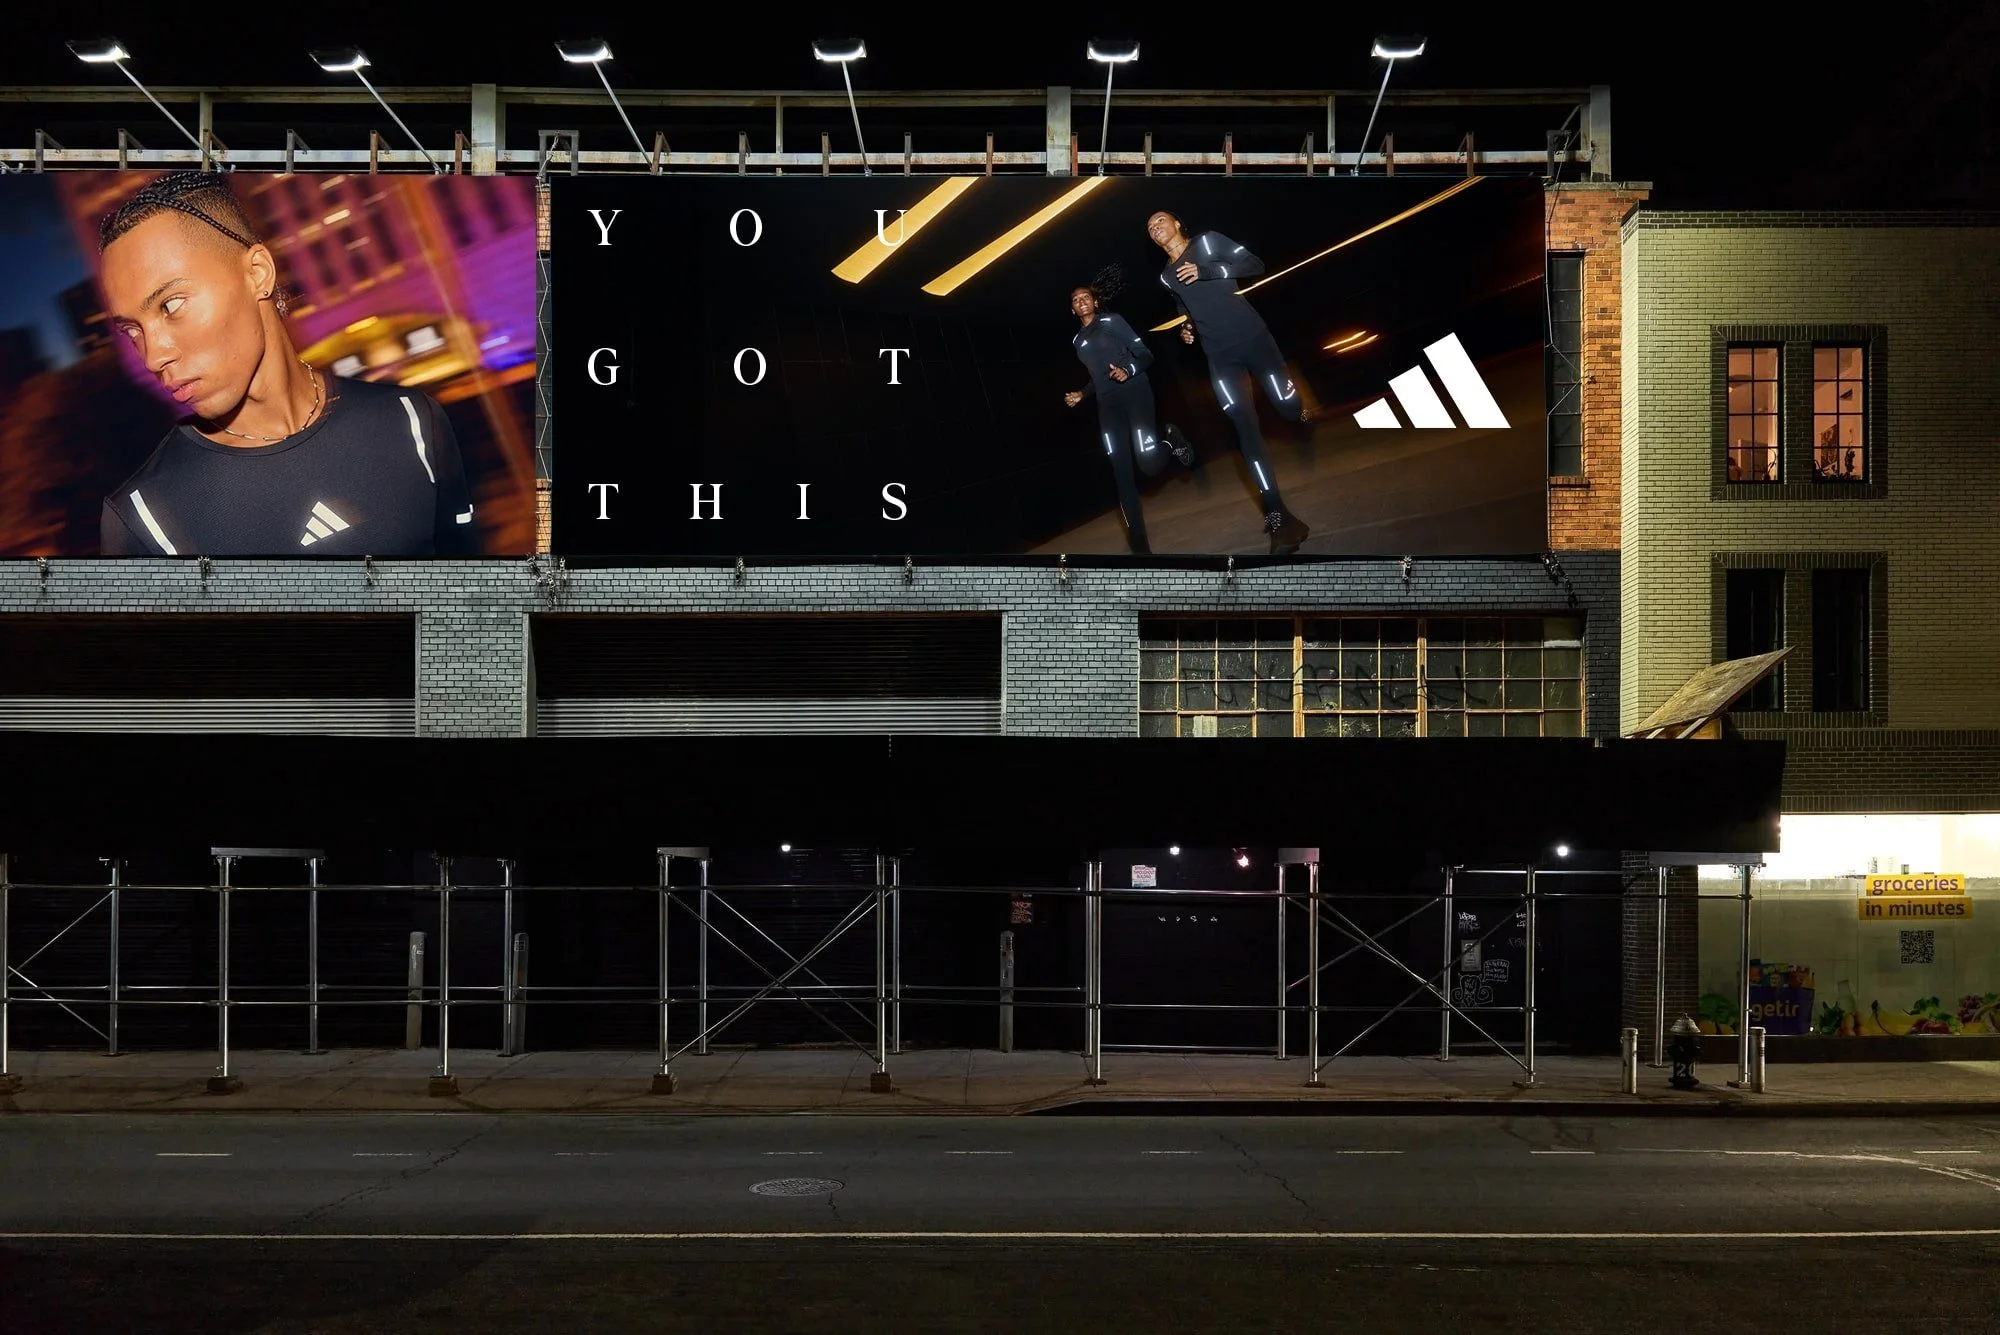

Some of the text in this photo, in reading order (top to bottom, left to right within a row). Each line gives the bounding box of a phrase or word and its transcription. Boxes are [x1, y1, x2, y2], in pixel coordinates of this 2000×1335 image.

[587, 208, 909, 248] YOU
[587, 347, 910, 386] GOT
[587, 482, 908, 521] THIS
[1872, 875, 1959, 896] groceries
[1865, 900, 1965, 916] in minutes
[1751, 999, 1801, 1022] getir
